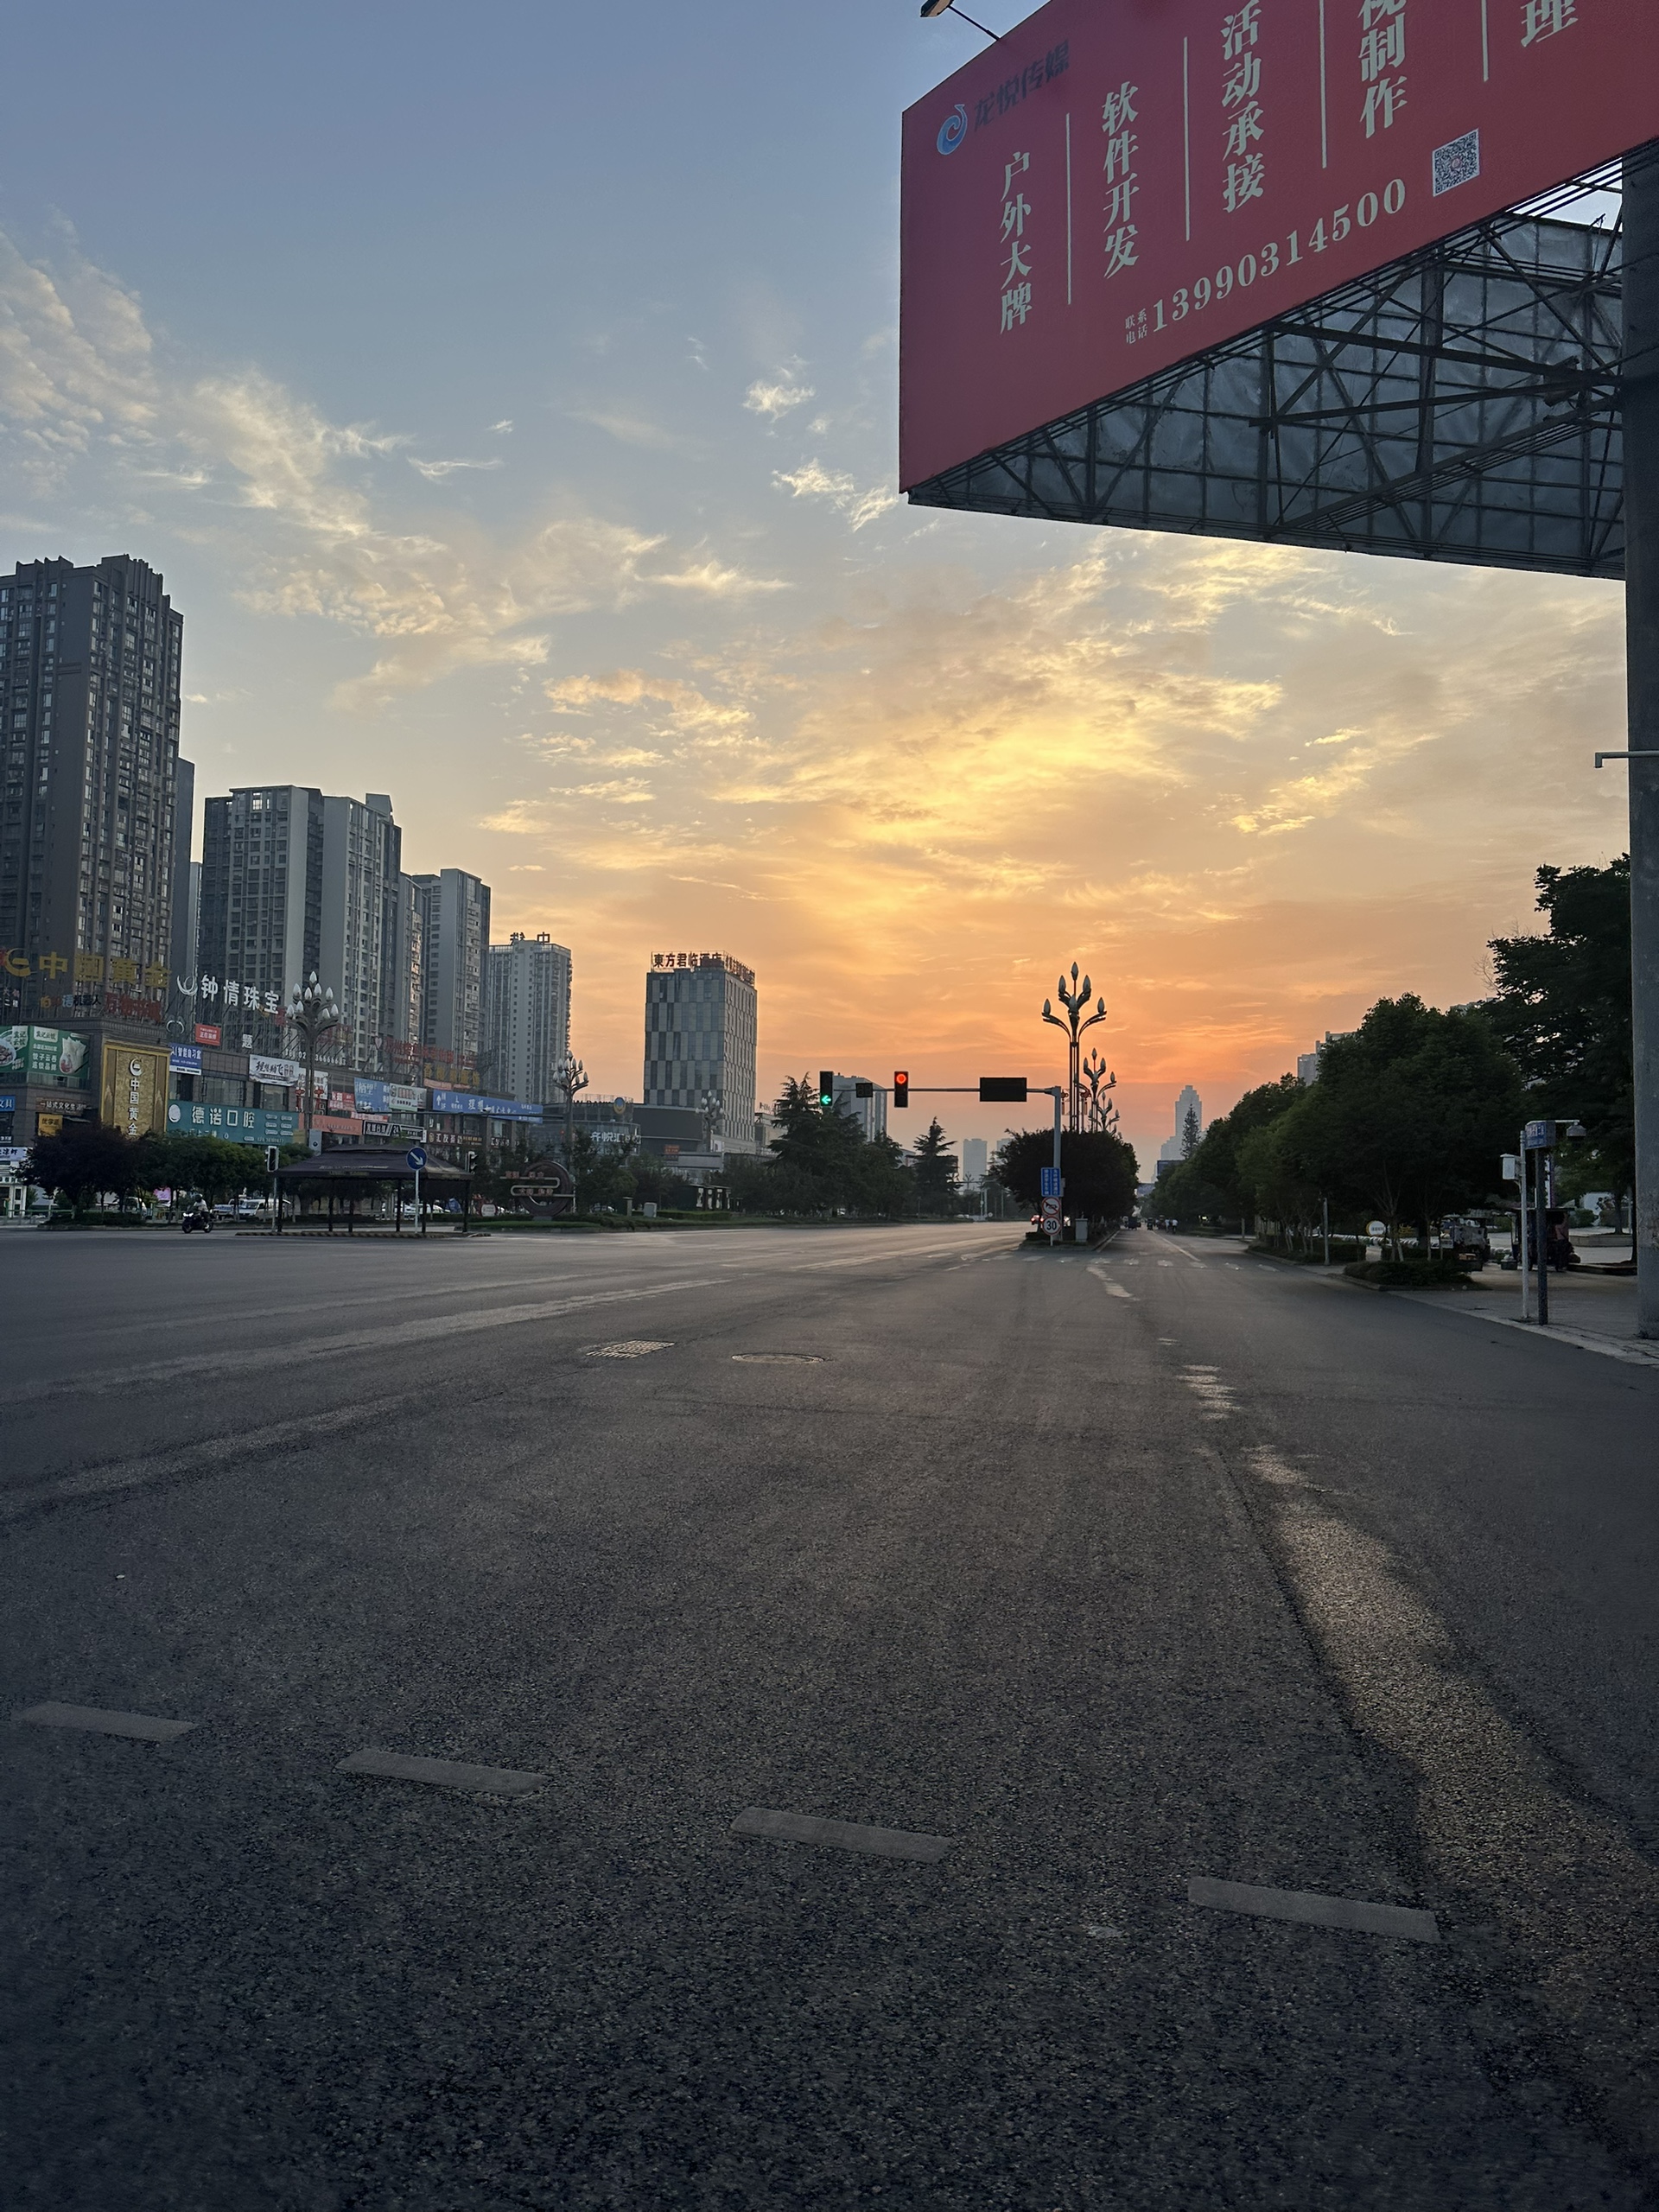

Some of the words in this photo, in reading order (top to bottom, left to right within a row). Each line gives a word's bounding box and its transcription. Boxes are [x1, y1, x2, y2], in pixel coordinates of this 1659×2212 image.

[974, 38, 1071, 132] 龙悦传媒
[1222, 0, 1265, 214] 活动承接
[1101, 81, 1140, 280] 软件开发
[999, 151, 1033, 335] 户外大牌
[1152, 178, 1407, 334] 13990314500
[1124, 308, 1147, 330] 联系
[1125, 323, 1148, 345] 电话
[200, 974, 279, 1014] 钟情珠宝
[127, 1078, 140, 1136] 中国黄金
[191, 1105, 255, 1129] 德诺口腔
[1046, 1220, 1057, 1230] 30
